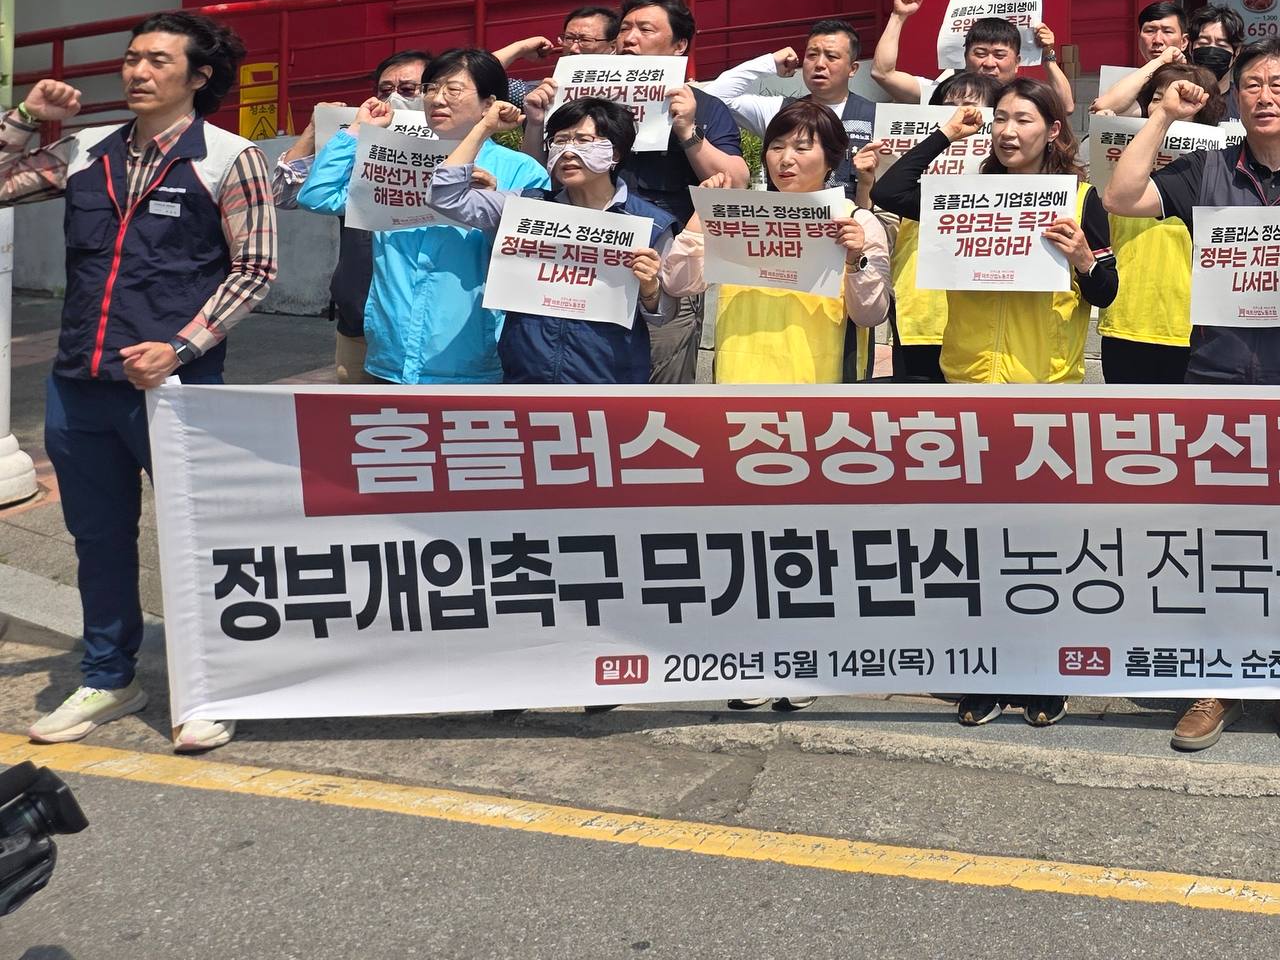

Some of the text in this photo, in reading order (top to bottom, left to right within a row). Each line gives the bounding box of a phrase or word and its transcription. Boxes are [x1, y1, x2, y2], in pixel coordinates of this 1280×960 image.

[951, 1, 1037, 18] 홈플러스 기업회생에
[1248, 23, 1278, 36] 650
[571, 69, 664, 83] 홈플러스 정상화
[632, 85, 666, 103] 전에
[890, 121, 941, 135] 홈플러스
[1164, 136, 1219, 151] 업회생에
[369, 144, 408, 165] 홈플러스
[361, 162, 417, 188] 지방선거
[933, 191, 1068, 211] 홈플러스 기업회생에
[712, 204, 831, 220] 홈플러스 정상화에
[937, 211, 1057, 234] 유암코는 즉각
[516, 218, 634, 247] 홈플러스 정상화에
[705, 219, 844, 239] 정부는 지금 당장
[1211, 227, 1259, 243] 홈플러스
[501, 236, 556, 260] 정부는
[562, 243, 599, 264] 지금
[747, 241, 803, 259] 나서라
[954, 236, 1032, 258] 개입하라
[1200, 247, 1247, 269] 정부는
[1250, 245, 1280, 267] 지금
[537, 263, 597, 287] 나서라
[1232, 271, 1279, 293] 나서라
[349, 408, 704, 495] 홈플러스
[725, 409, 989, 486] 정상화
[213, 531, 624, 642] 정부개입촉구
[640, 527, 838, 625] 무기한
[853, 527, 981, 618] 단식
[999, 526, 1125, 616] 농성
[601, 658, 643, 681] 일시
[664, 653, 764, 683] 2026년
[773, 649, 819, 680] 5월
[827, 646, 934, 679] 14일(목)
[945, 647, 997, 675] 11시
[1063, 649, 1105, 672] 장소
[1125, 646, 1233, 680] 홈플러스
